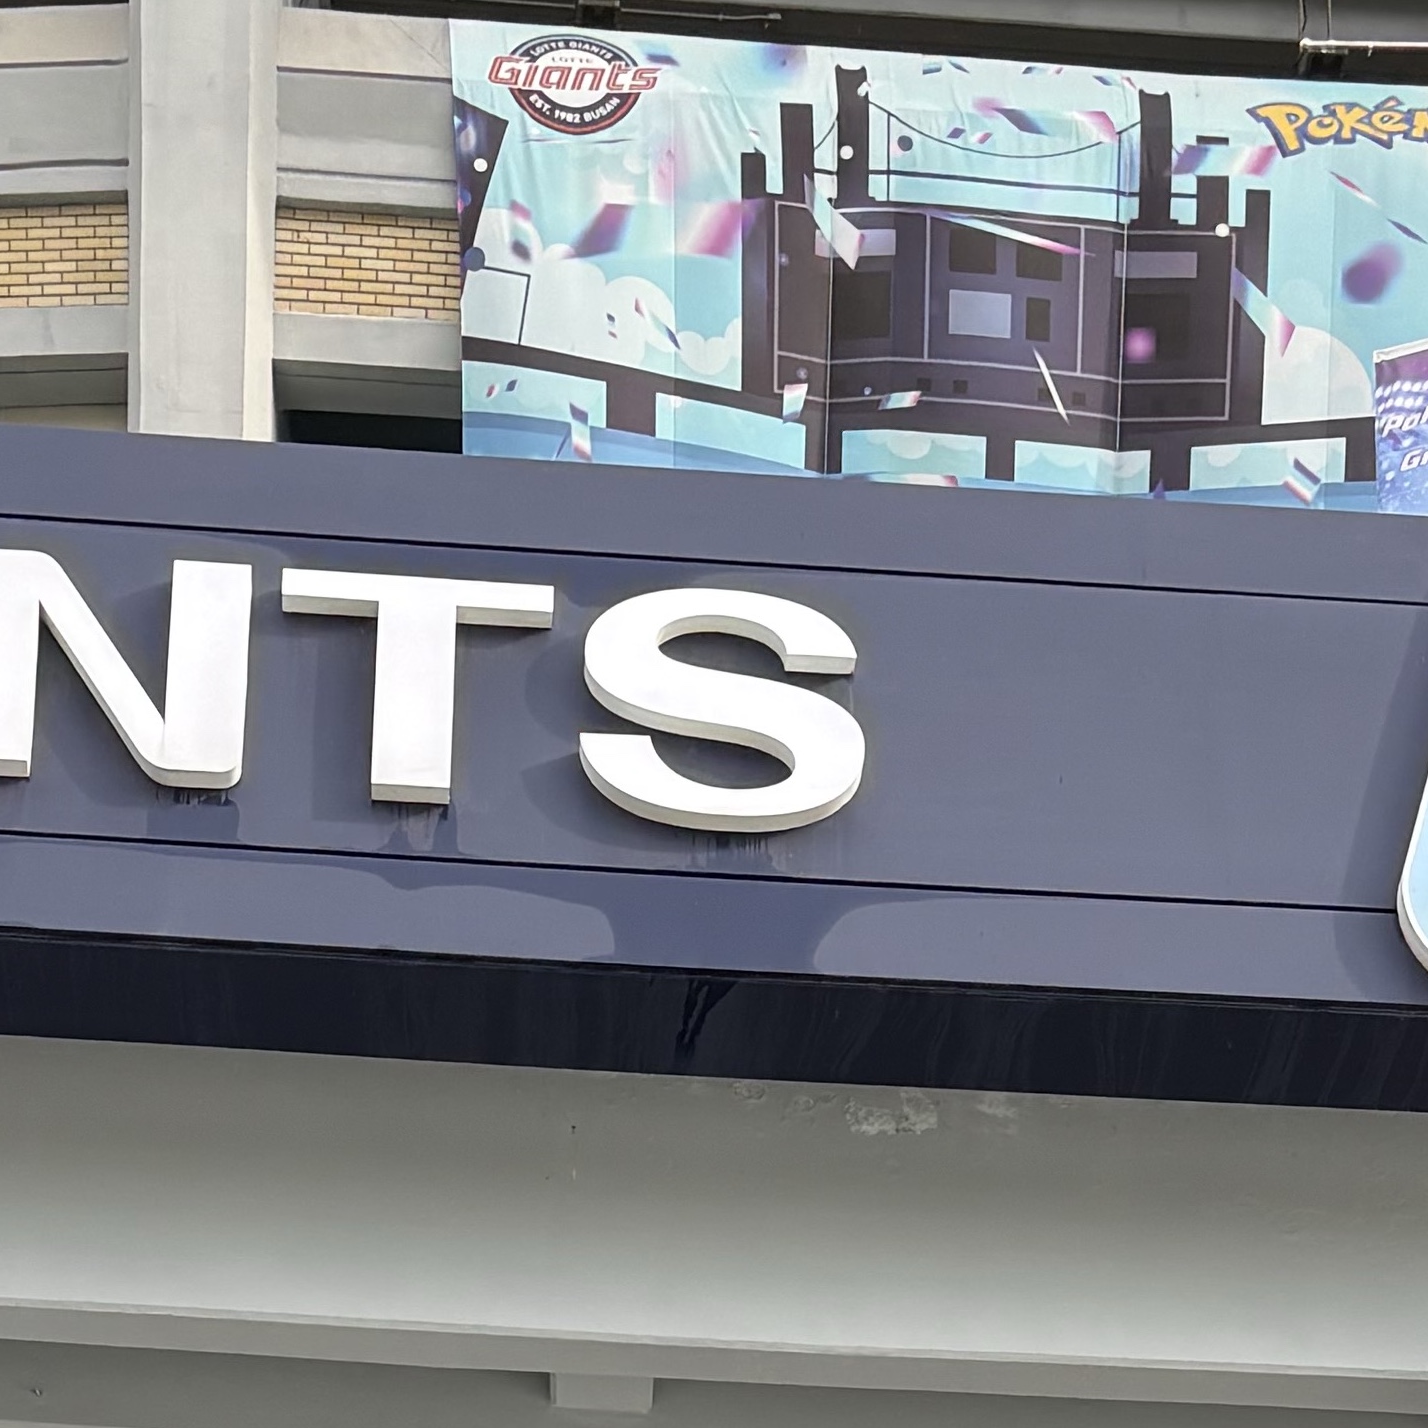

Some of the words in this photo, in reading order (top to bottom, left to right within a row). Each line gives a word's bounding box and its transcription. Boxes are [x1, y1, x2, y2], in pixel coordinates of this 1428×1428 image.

[529, 41, 566, 57] LOTTE
[569, 42, 614, 60] GIANTS
[487, 55, 663, 91] Giants
[583, 97, 621, 123] BUSAN
